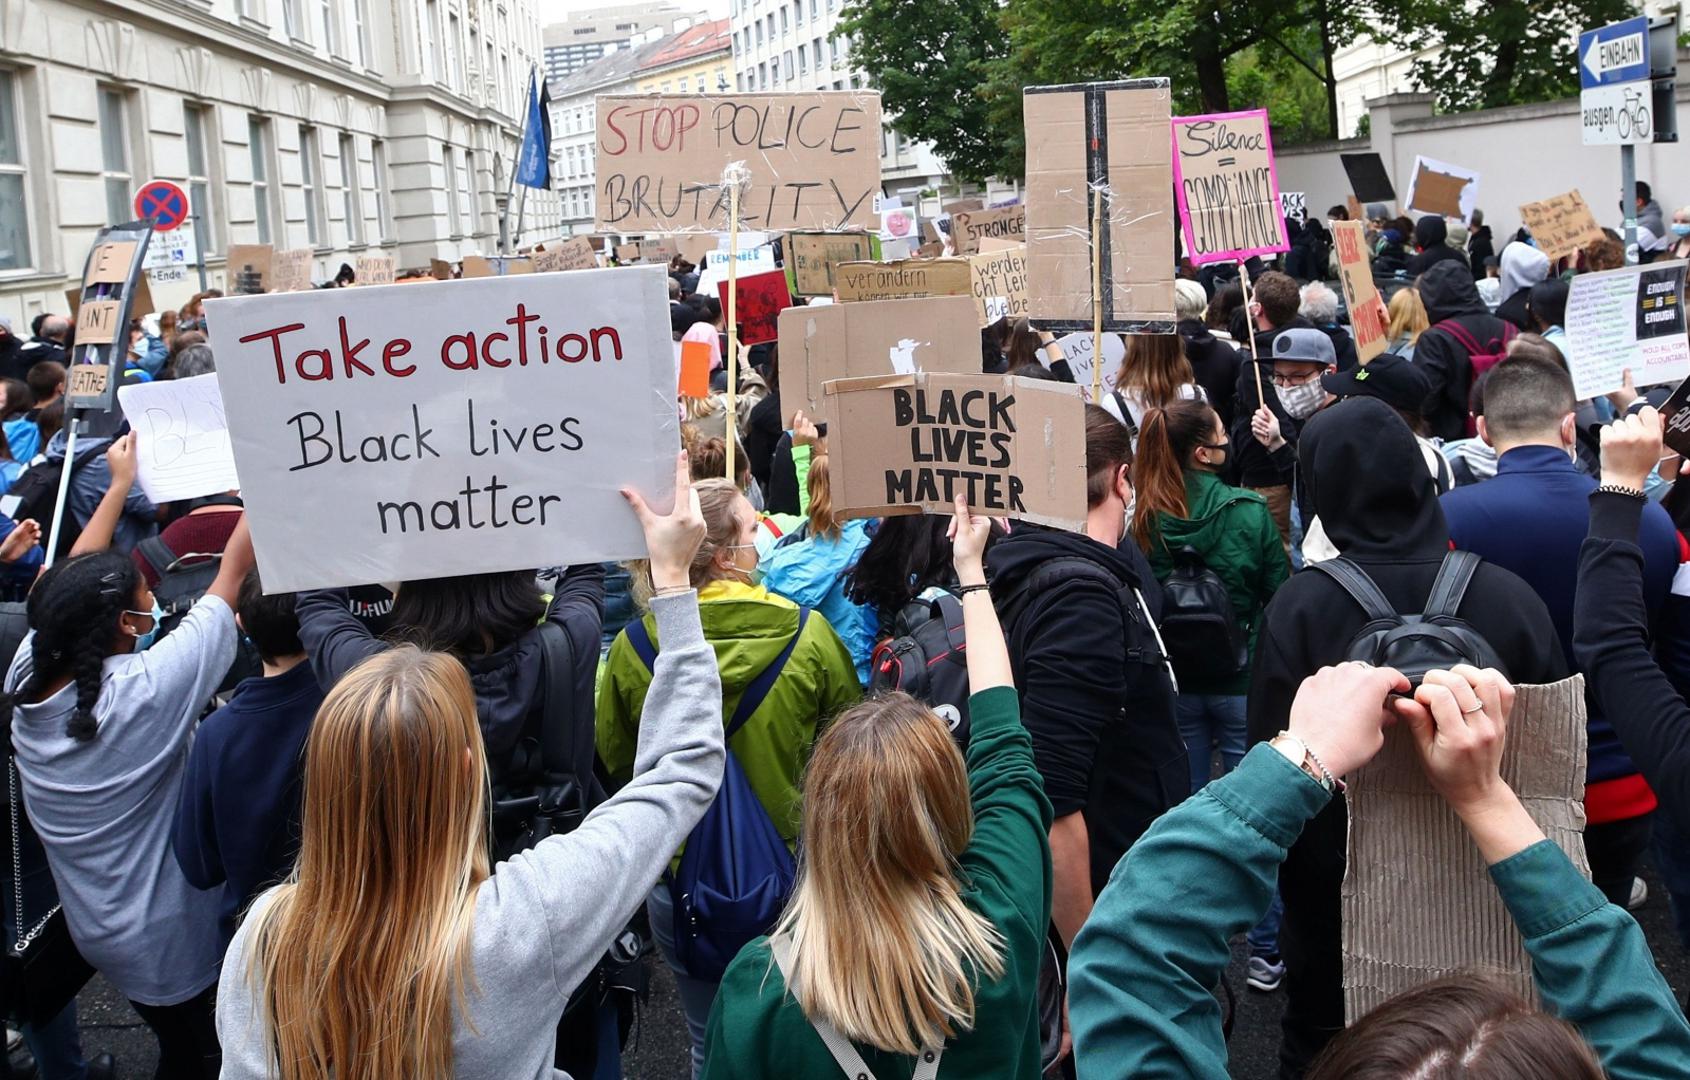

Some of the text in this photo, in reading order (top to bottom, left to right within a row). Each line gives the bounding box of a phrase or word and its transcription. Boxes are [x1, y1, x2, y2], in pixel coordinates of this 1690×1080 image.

[1600, 38, 1640, 69] EINBAHN
[600, 101, 864, 156] STOP POLICE
[1583, 106, 1617, 132] ausgen.
[1180, 120, 1267, 157] Silence
[1282, 193, 1305, 206] ACK
[1282, 205, 1305, 219] VES
[967, 216, 1026, 241] STRONGE
[157, 269, 181, 281] Ende
[1647, 280, 1676, 295] ENOUGH
[982, 294, 1029, 319] bleibe
[1655, 296, 1664, 307] IS
[1645, 309, 1676, 324] ENOUGH
[239, 303, 623, 384] Take action
[1671, 342, 1687, 350] COPS
[893, 388, 1017, 433] BLACK
[286, 398, 584, 472] Black lives
[910, 427, 1012, 469] LIVES
[885, 467, 1027, 513] MATTER
[376, 474, 562, 535] matter
